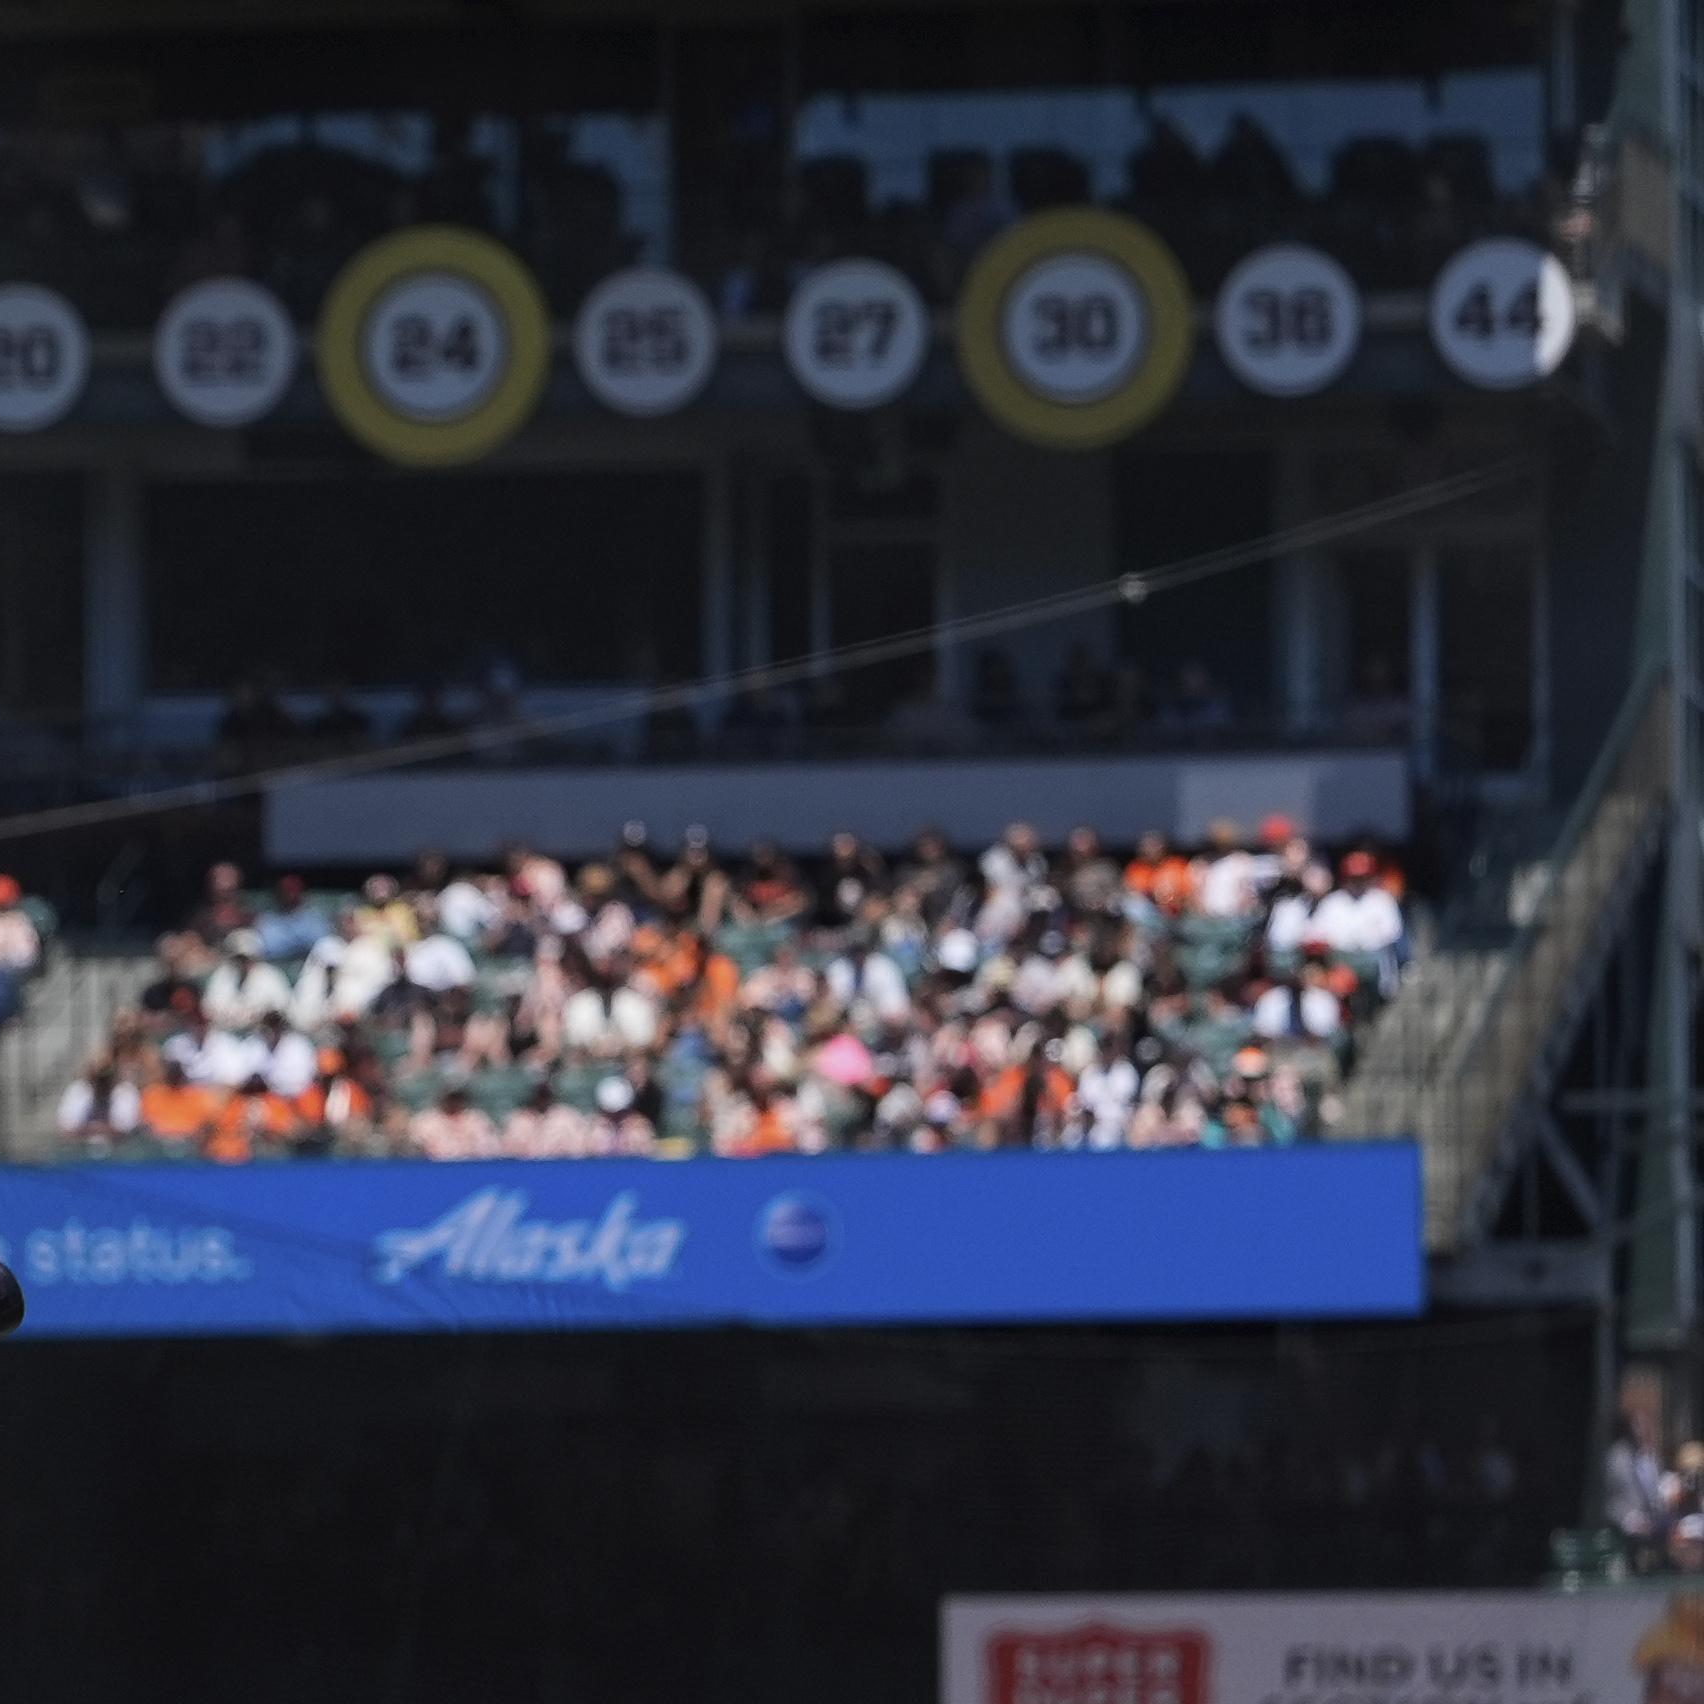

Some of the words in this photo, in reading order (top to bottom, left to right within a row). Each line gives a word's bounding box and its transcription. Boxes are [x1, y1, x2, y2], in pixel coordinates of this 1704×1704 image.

[394, 314, 479, 381] 24
[814, 300, 896, 370] 27
[1033, 294, 1118, 364] 30
[1456, 288, 1544, 340] 44
[372, 1184, 685, 1294] Alaska
[1283, 1643, 1415, 1689] FIND
[1426, 1643, 1502, 1689] US
[1514, 1643, 1575, 1688] IN
